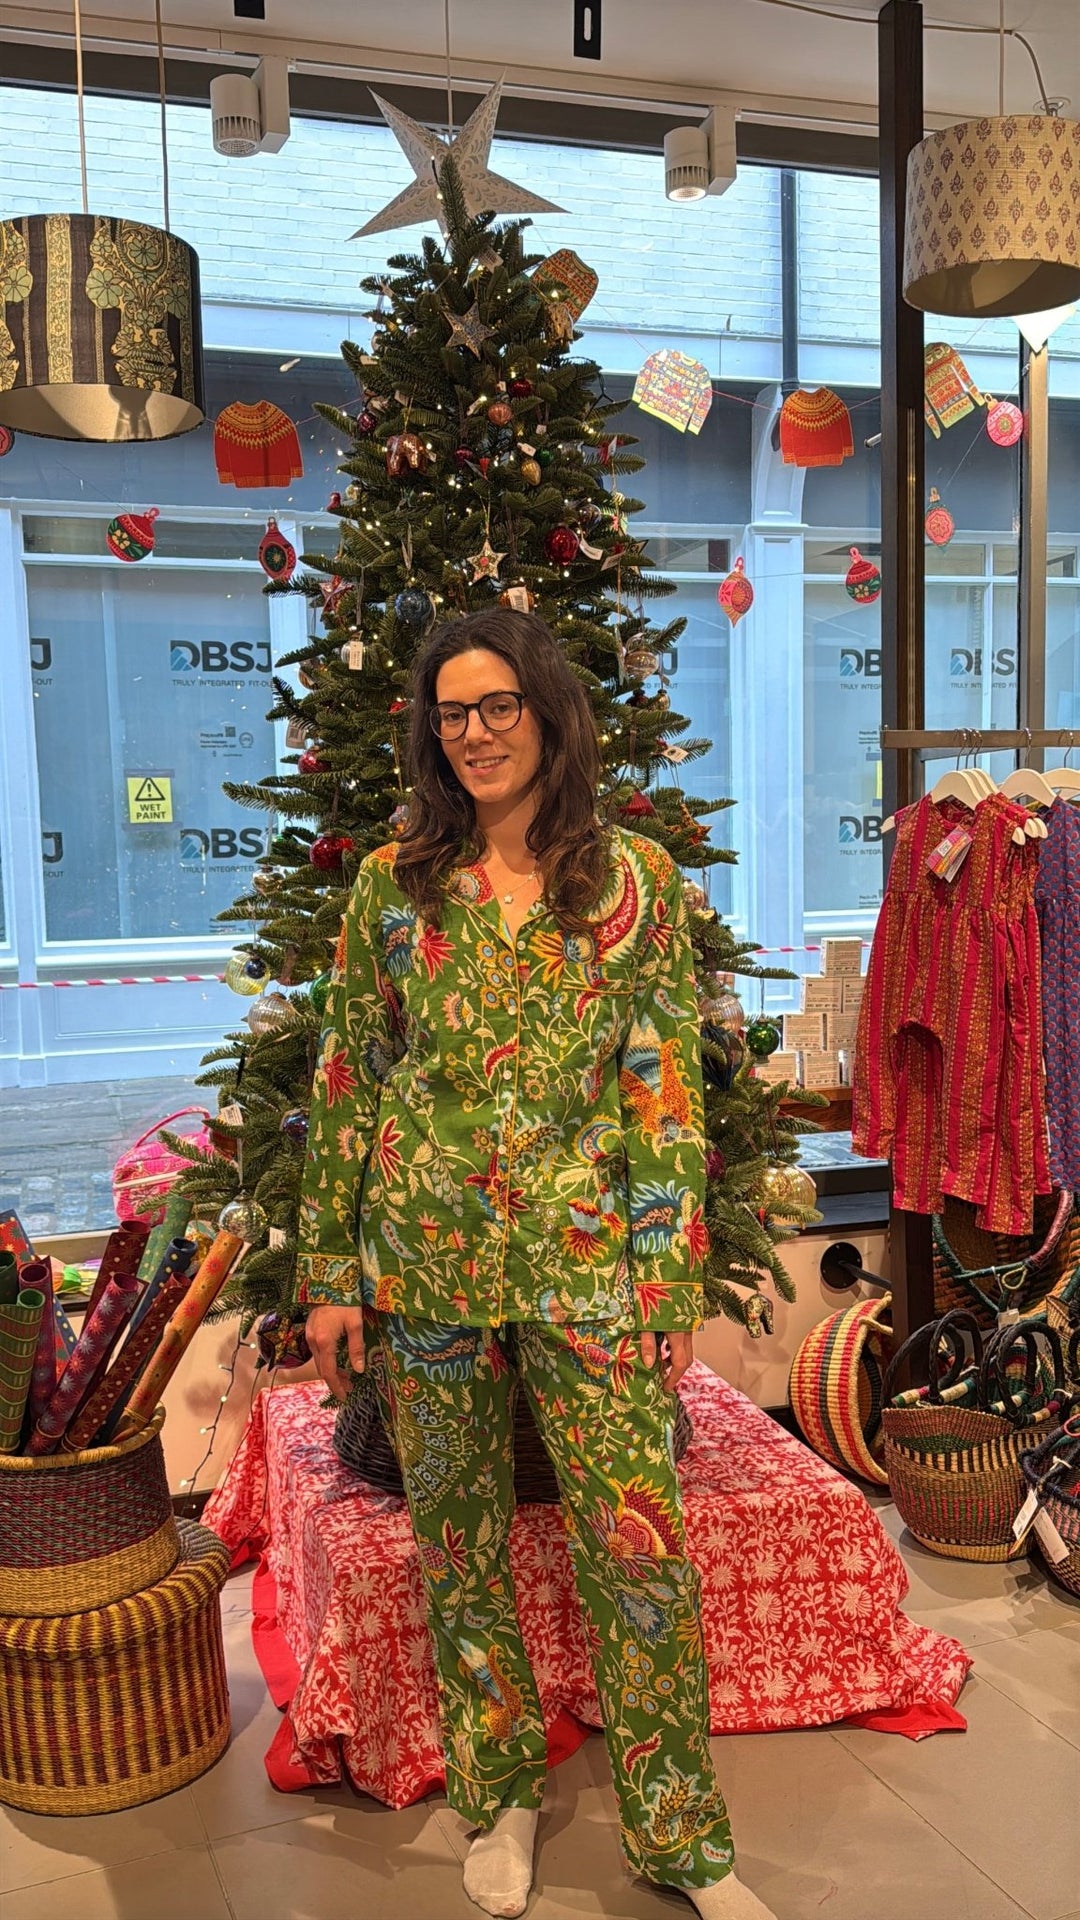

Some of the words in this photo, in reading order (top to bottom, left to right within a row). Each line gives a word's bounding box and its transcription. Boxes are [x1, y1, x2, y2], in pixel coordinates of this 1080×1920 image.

[170, 640, 272, 673] DBSJ
[136, 811, 166, 820] PAINT
[181, 827, 277, 859] DBS
[208, 865, 255, 873] INTEGRATED
